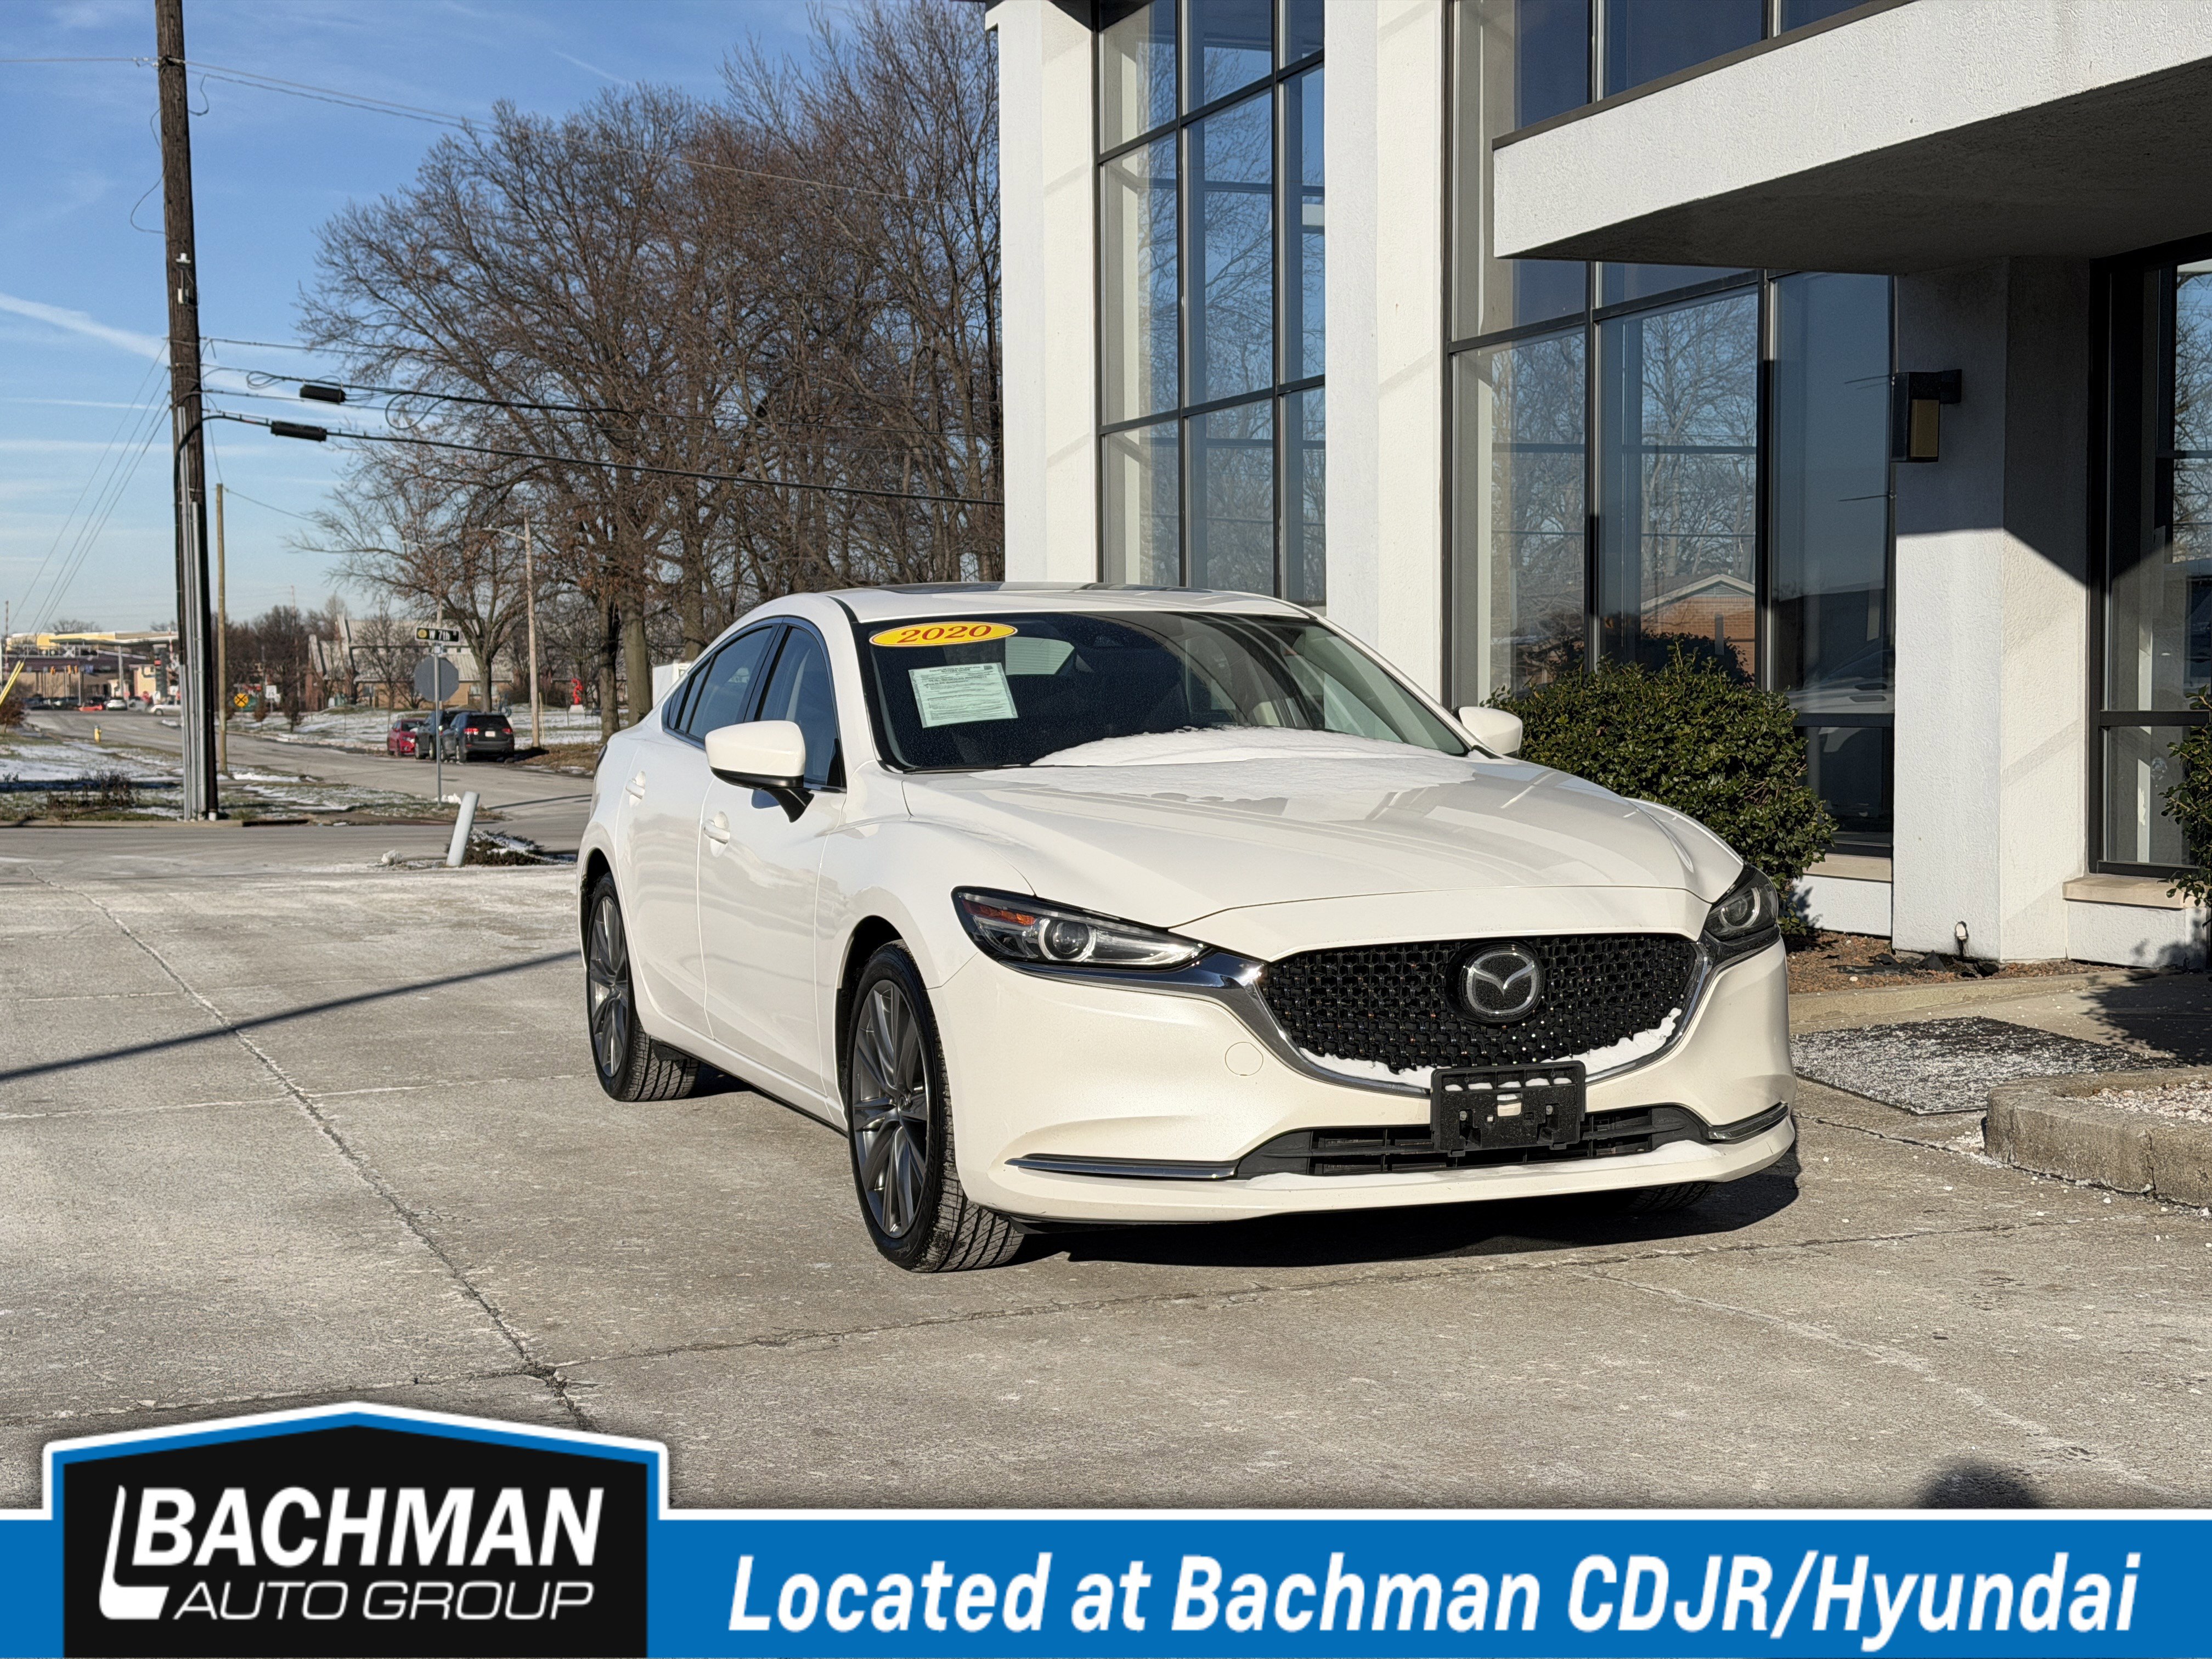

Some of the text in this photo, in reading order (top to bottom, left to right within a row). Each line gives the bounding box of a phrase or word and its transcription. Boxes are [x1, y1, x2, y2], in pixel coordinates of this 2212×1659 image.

[428, 629, 436, 640] W
[438, 630, 450, 641] 7th
[896, 625, 992, 644] 2020
